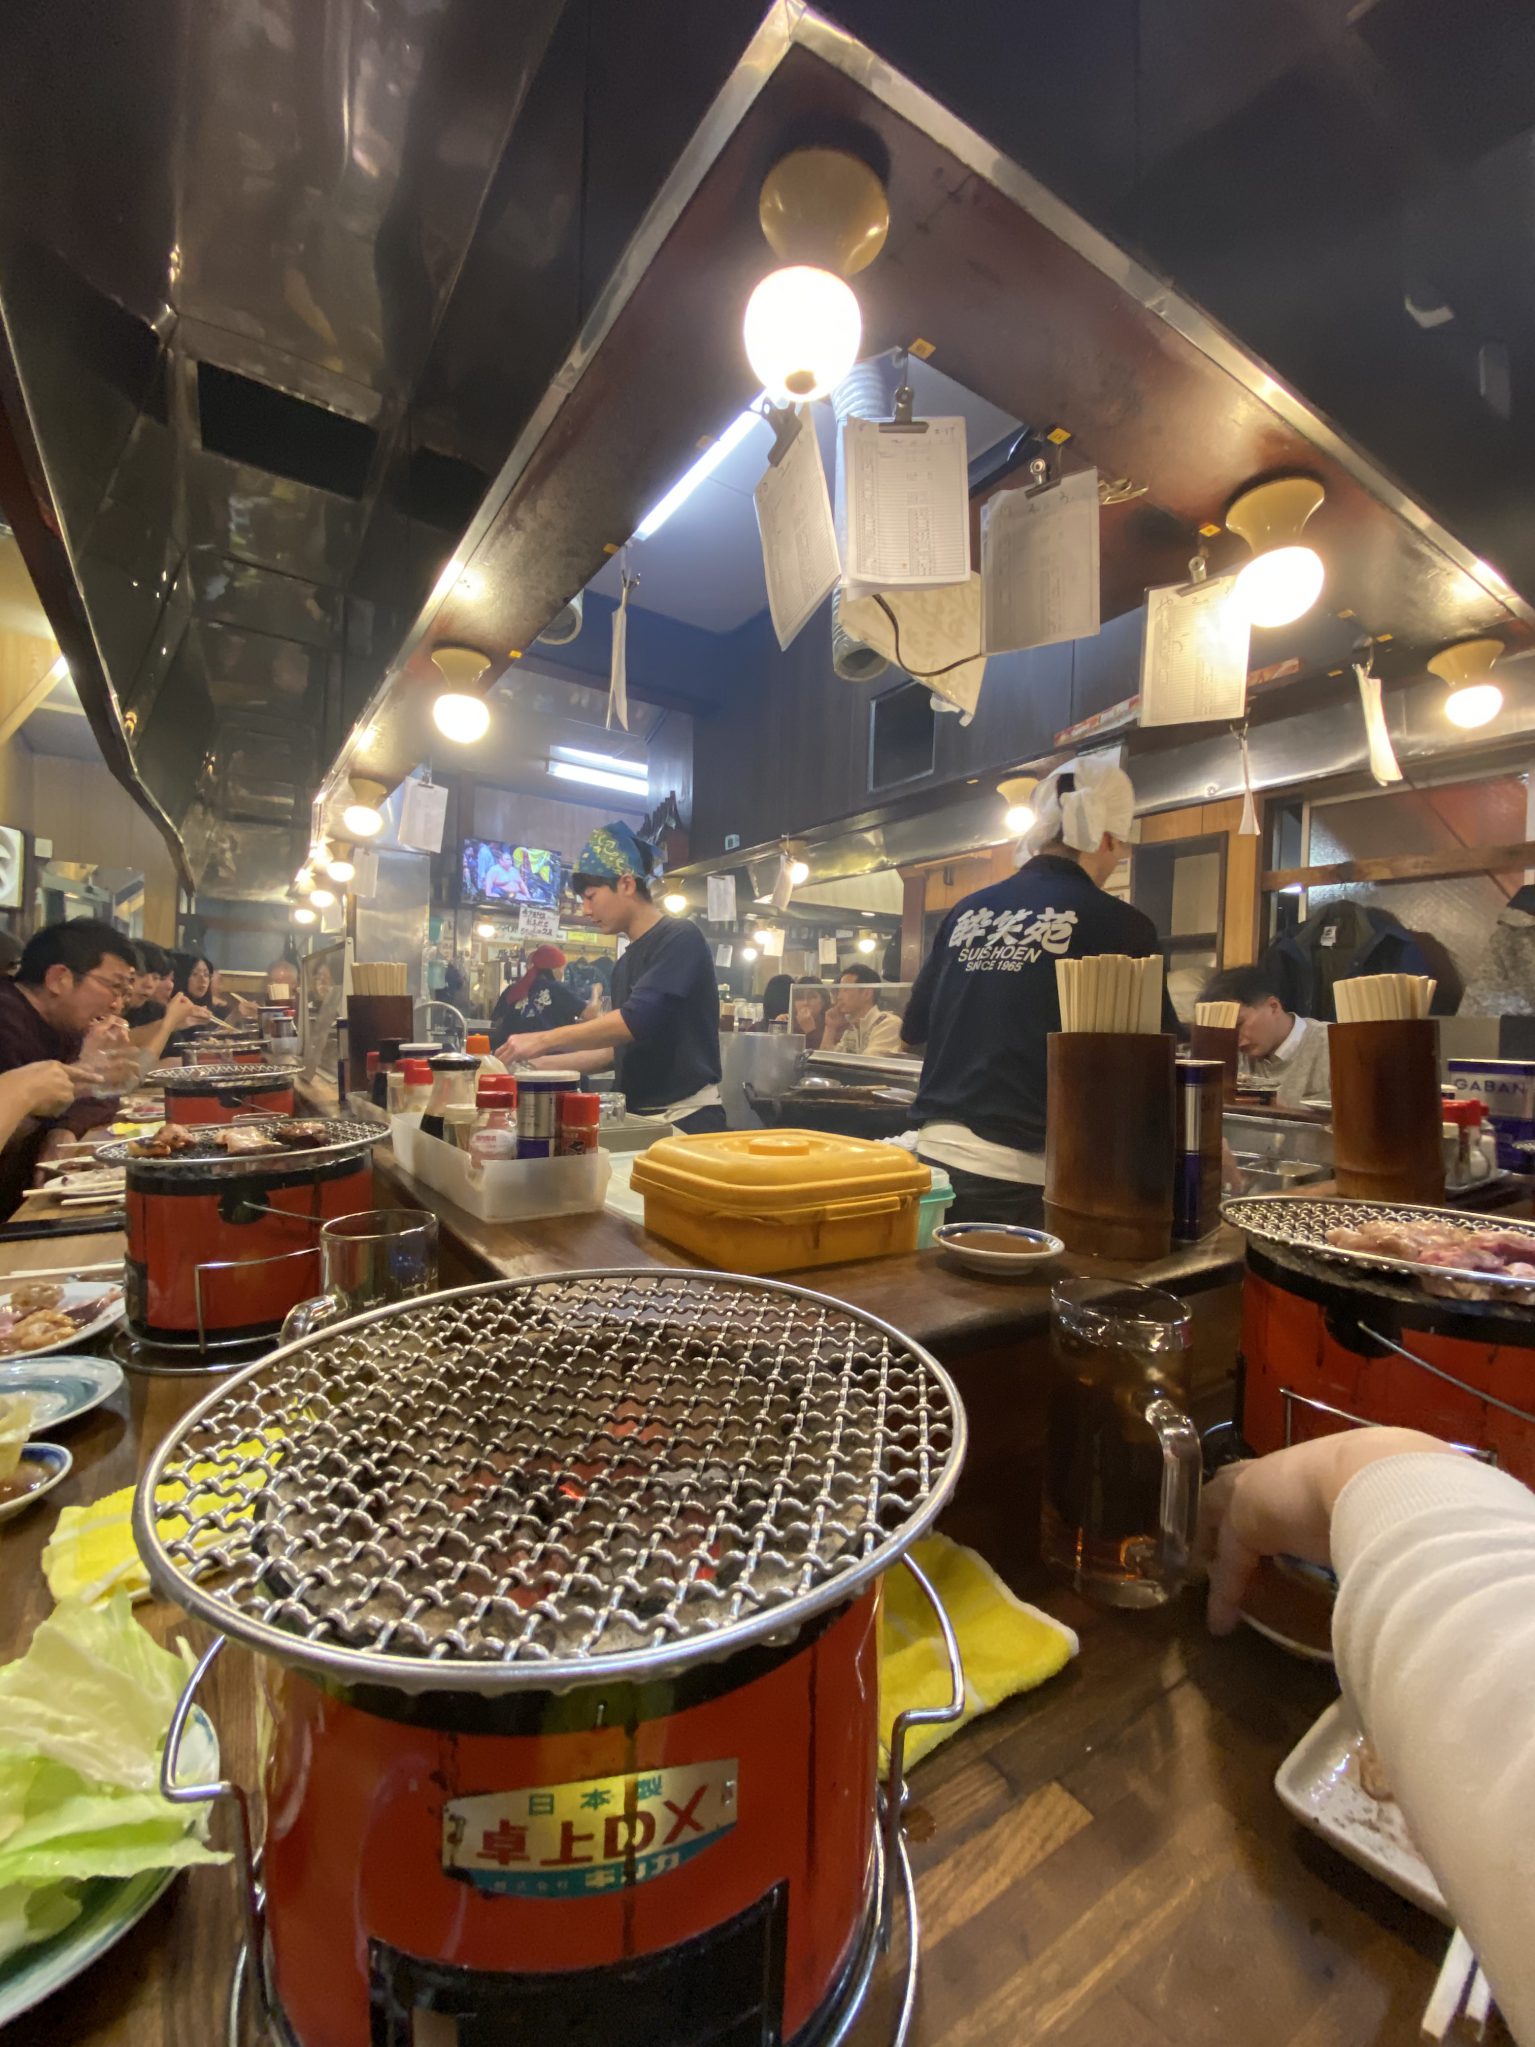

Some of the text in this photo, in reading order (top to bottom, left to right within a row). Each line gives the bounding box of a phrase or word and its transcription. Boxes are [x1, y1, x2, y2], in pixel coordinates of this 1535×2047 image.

[958, 945, 1042, 963] SUISHOEN
[965, 960, 1024, 972] SNCE 1965
[1454, 1078, 1526, 1095] GABAN
[528, 1775, 663, 1816] 日本製
[475, 1784, 709, 1866] 卓上DX
